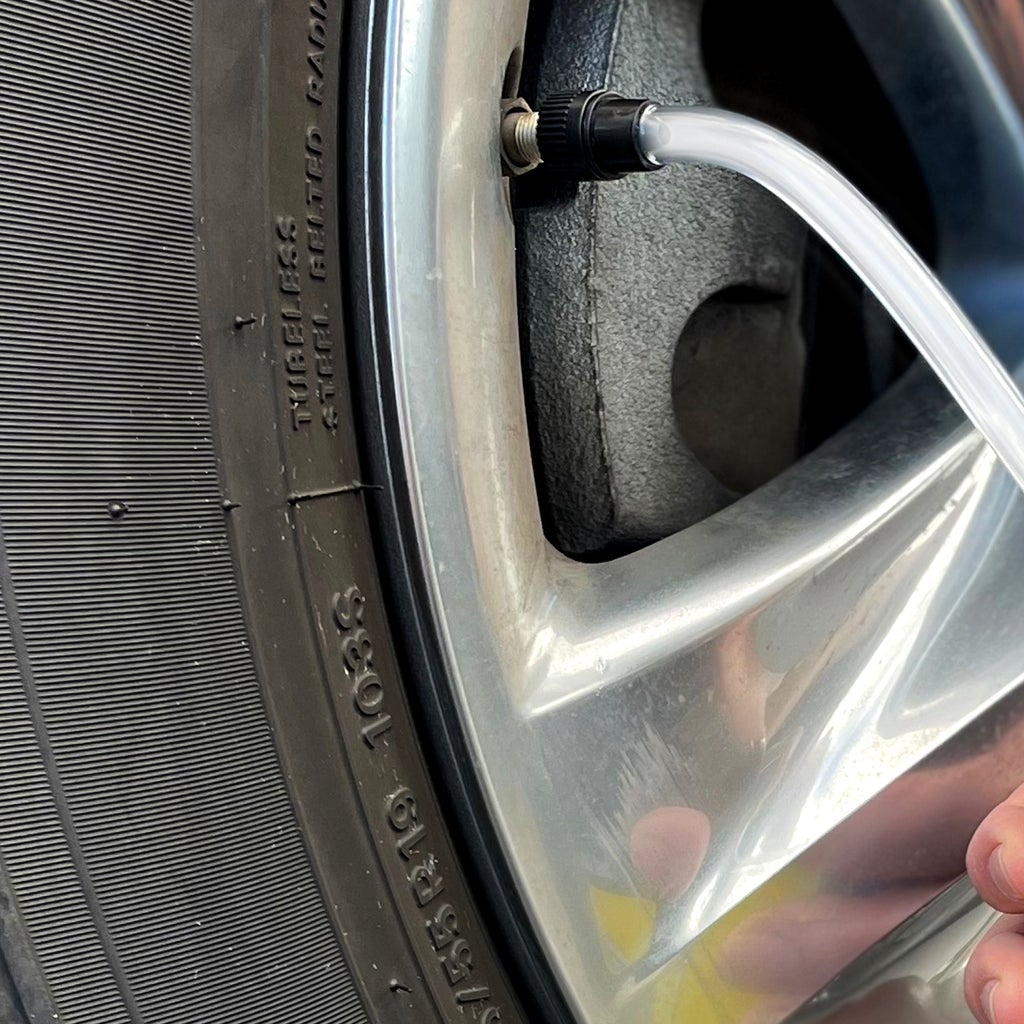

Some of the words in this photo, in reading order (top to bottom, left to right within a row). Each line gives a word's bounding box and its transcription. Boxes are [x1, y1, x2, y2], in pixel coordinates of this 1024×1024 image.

[306, 0, 330, 106] RADI
[304, 125, 328, 282] BELTED
[276, 214, 313, 433] TUBELESS
